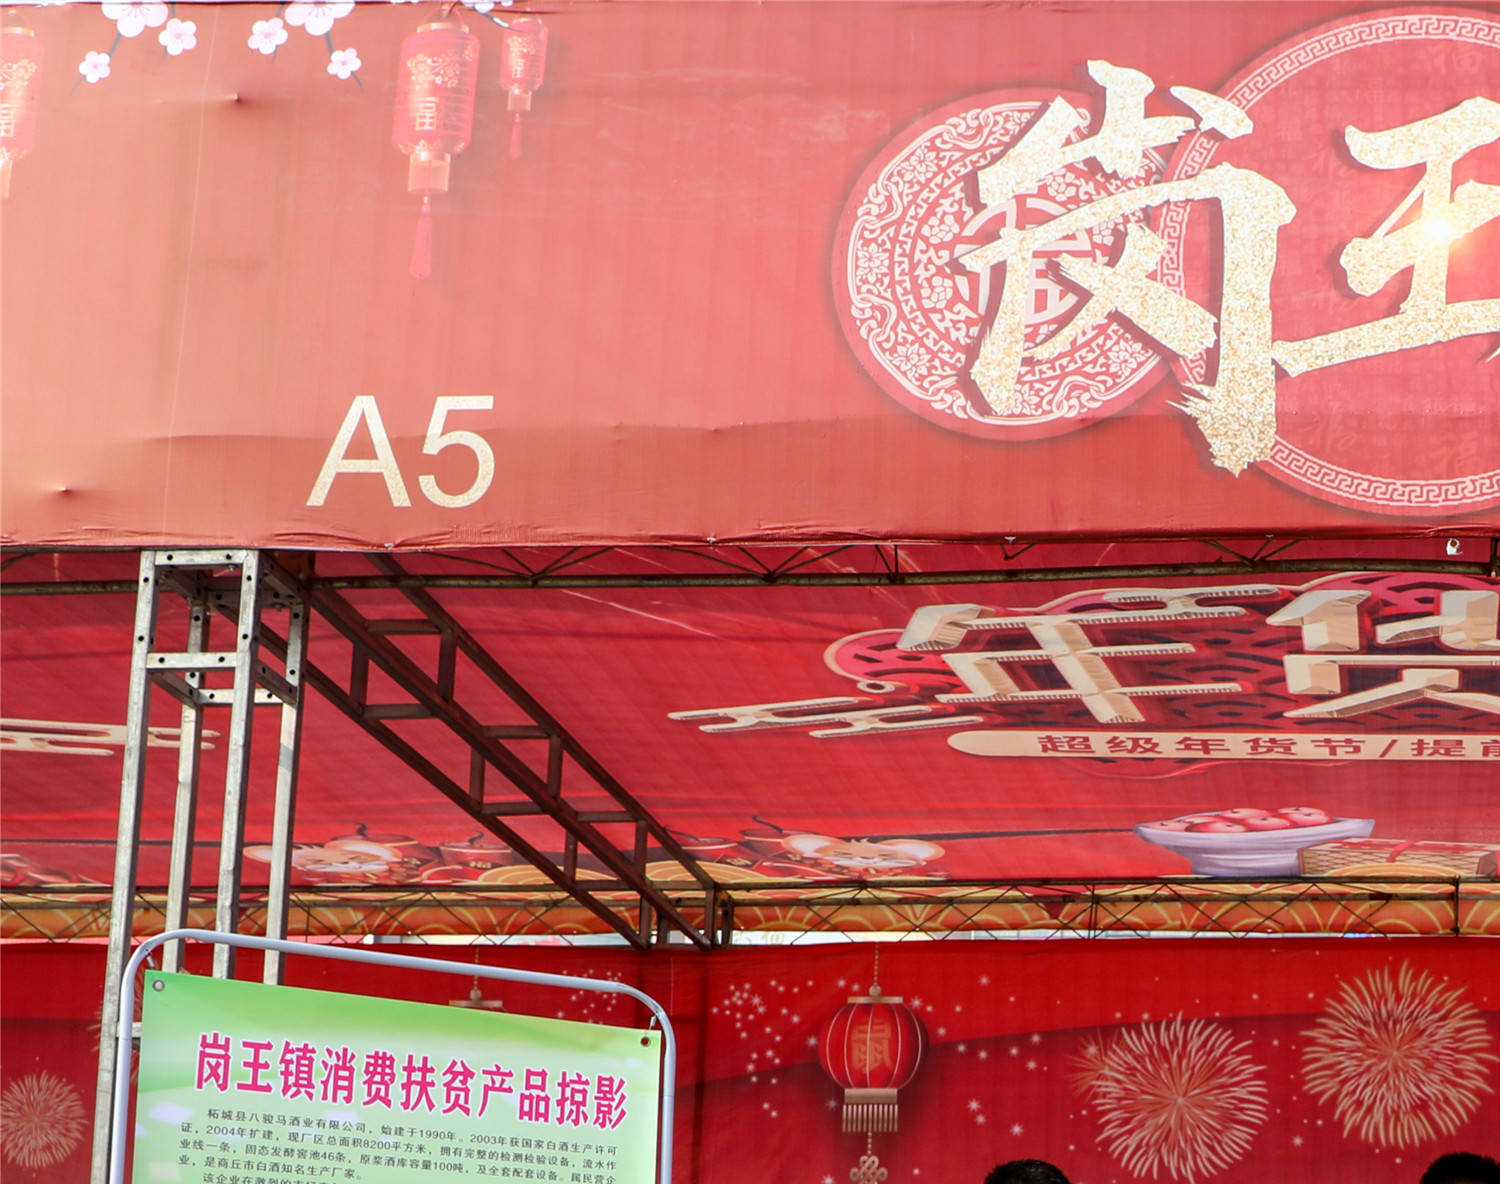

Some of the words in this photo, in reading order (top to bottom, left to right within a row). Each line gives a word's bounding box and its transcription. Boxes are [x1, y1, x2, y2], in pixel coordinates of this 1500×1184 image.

[306, 394, 496, 508] A5
[195, 1031, 628, 1131] 岗王镇消费扶贫产品掠影
